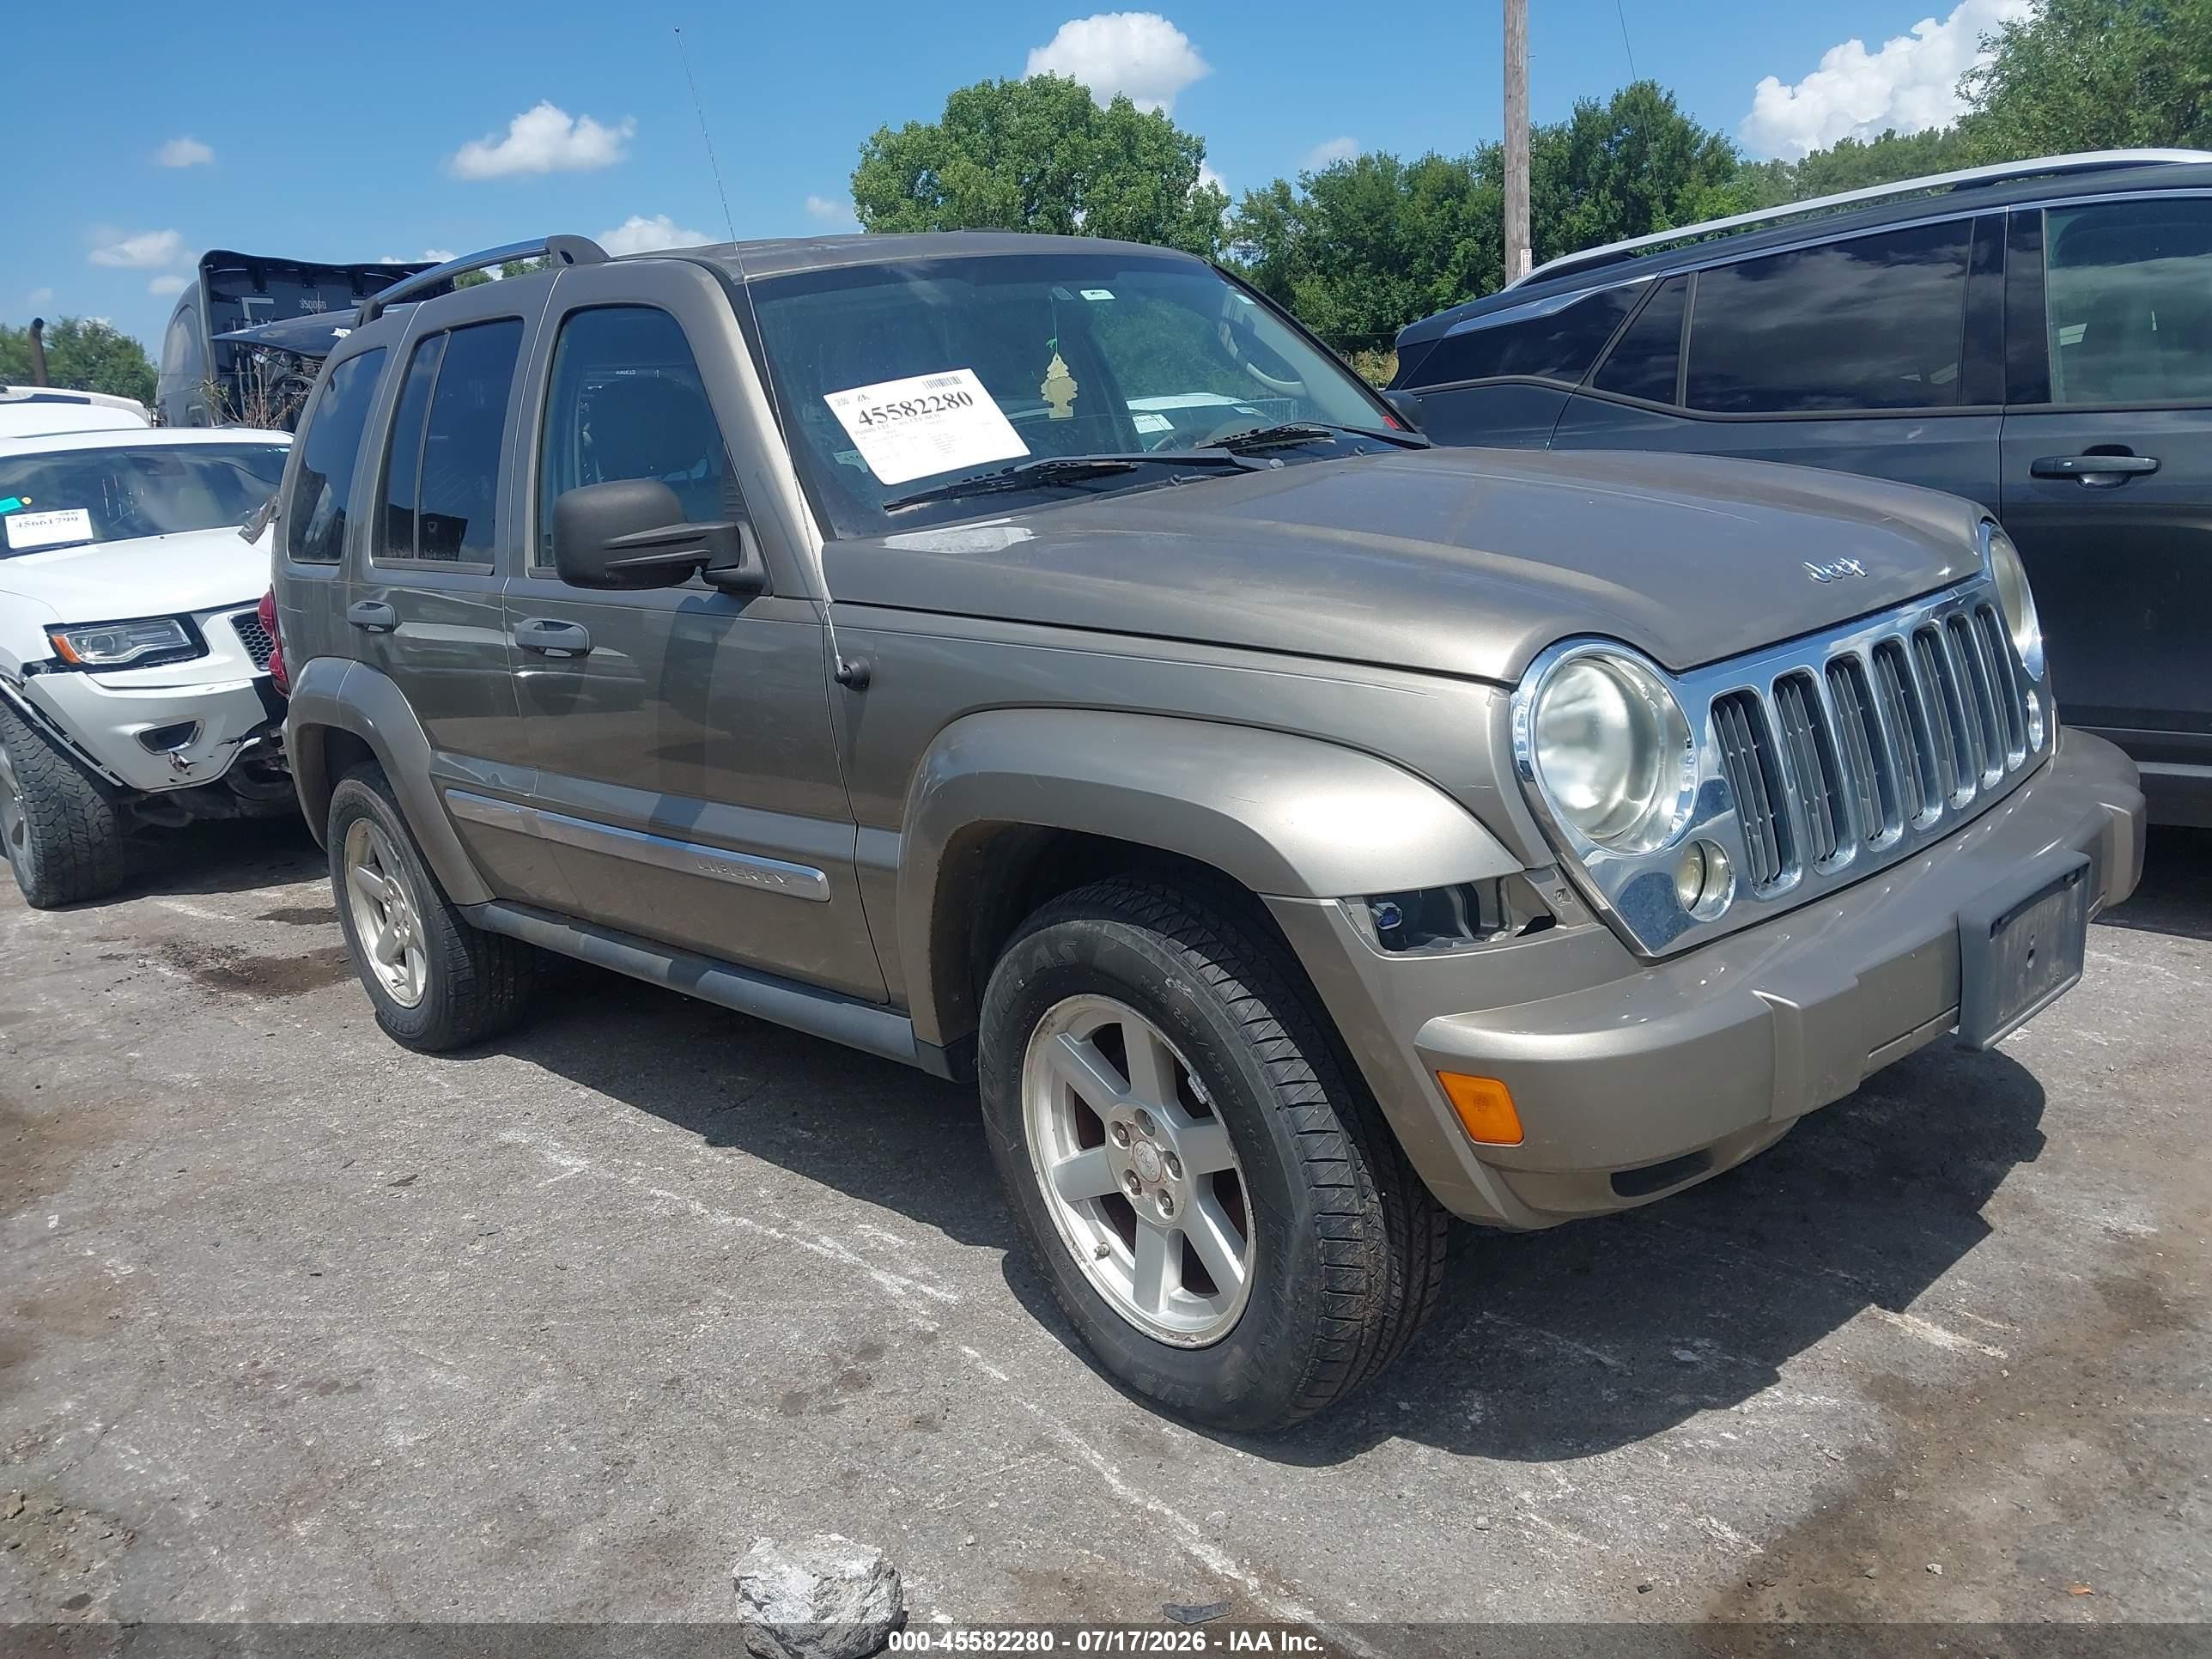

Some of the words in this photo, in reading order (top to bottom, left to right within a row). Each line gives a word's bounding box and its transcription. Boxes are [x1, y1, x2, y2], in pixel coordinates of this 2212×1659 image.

[858, 391, 974, 427] 45582280
[1803, 557, 1869, 583] Jeep
[695, 859, 789, 888] LIBERTY
